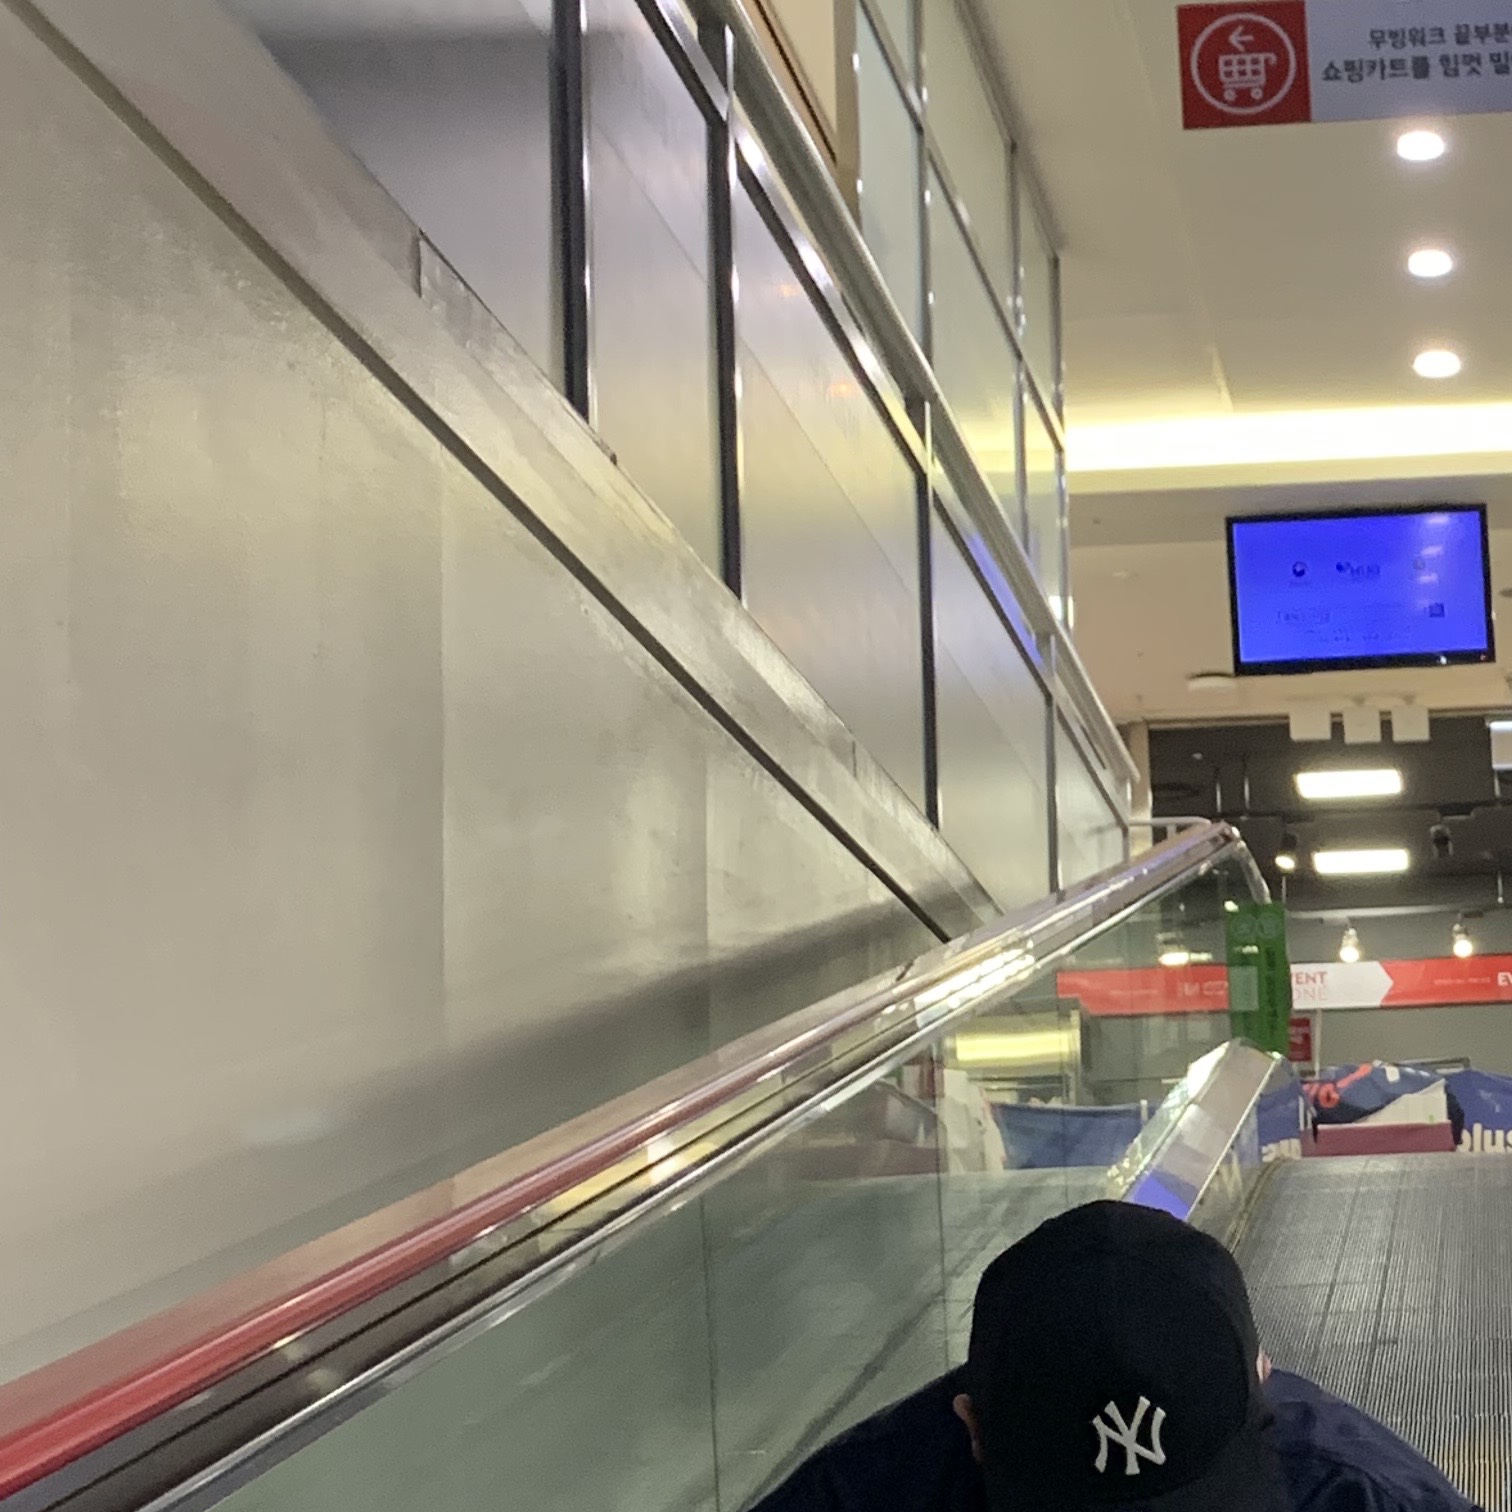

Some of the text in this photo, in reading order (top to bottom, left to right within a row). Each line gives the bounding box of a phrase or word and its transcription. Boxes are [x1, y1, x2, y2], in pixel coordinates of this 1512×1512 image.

[1368, 26, 1446, 50] 무빙워크
[1321, 54, 1431, 84] 쇼핑카트를
[1091, 1395, 1167, 1476] NY
